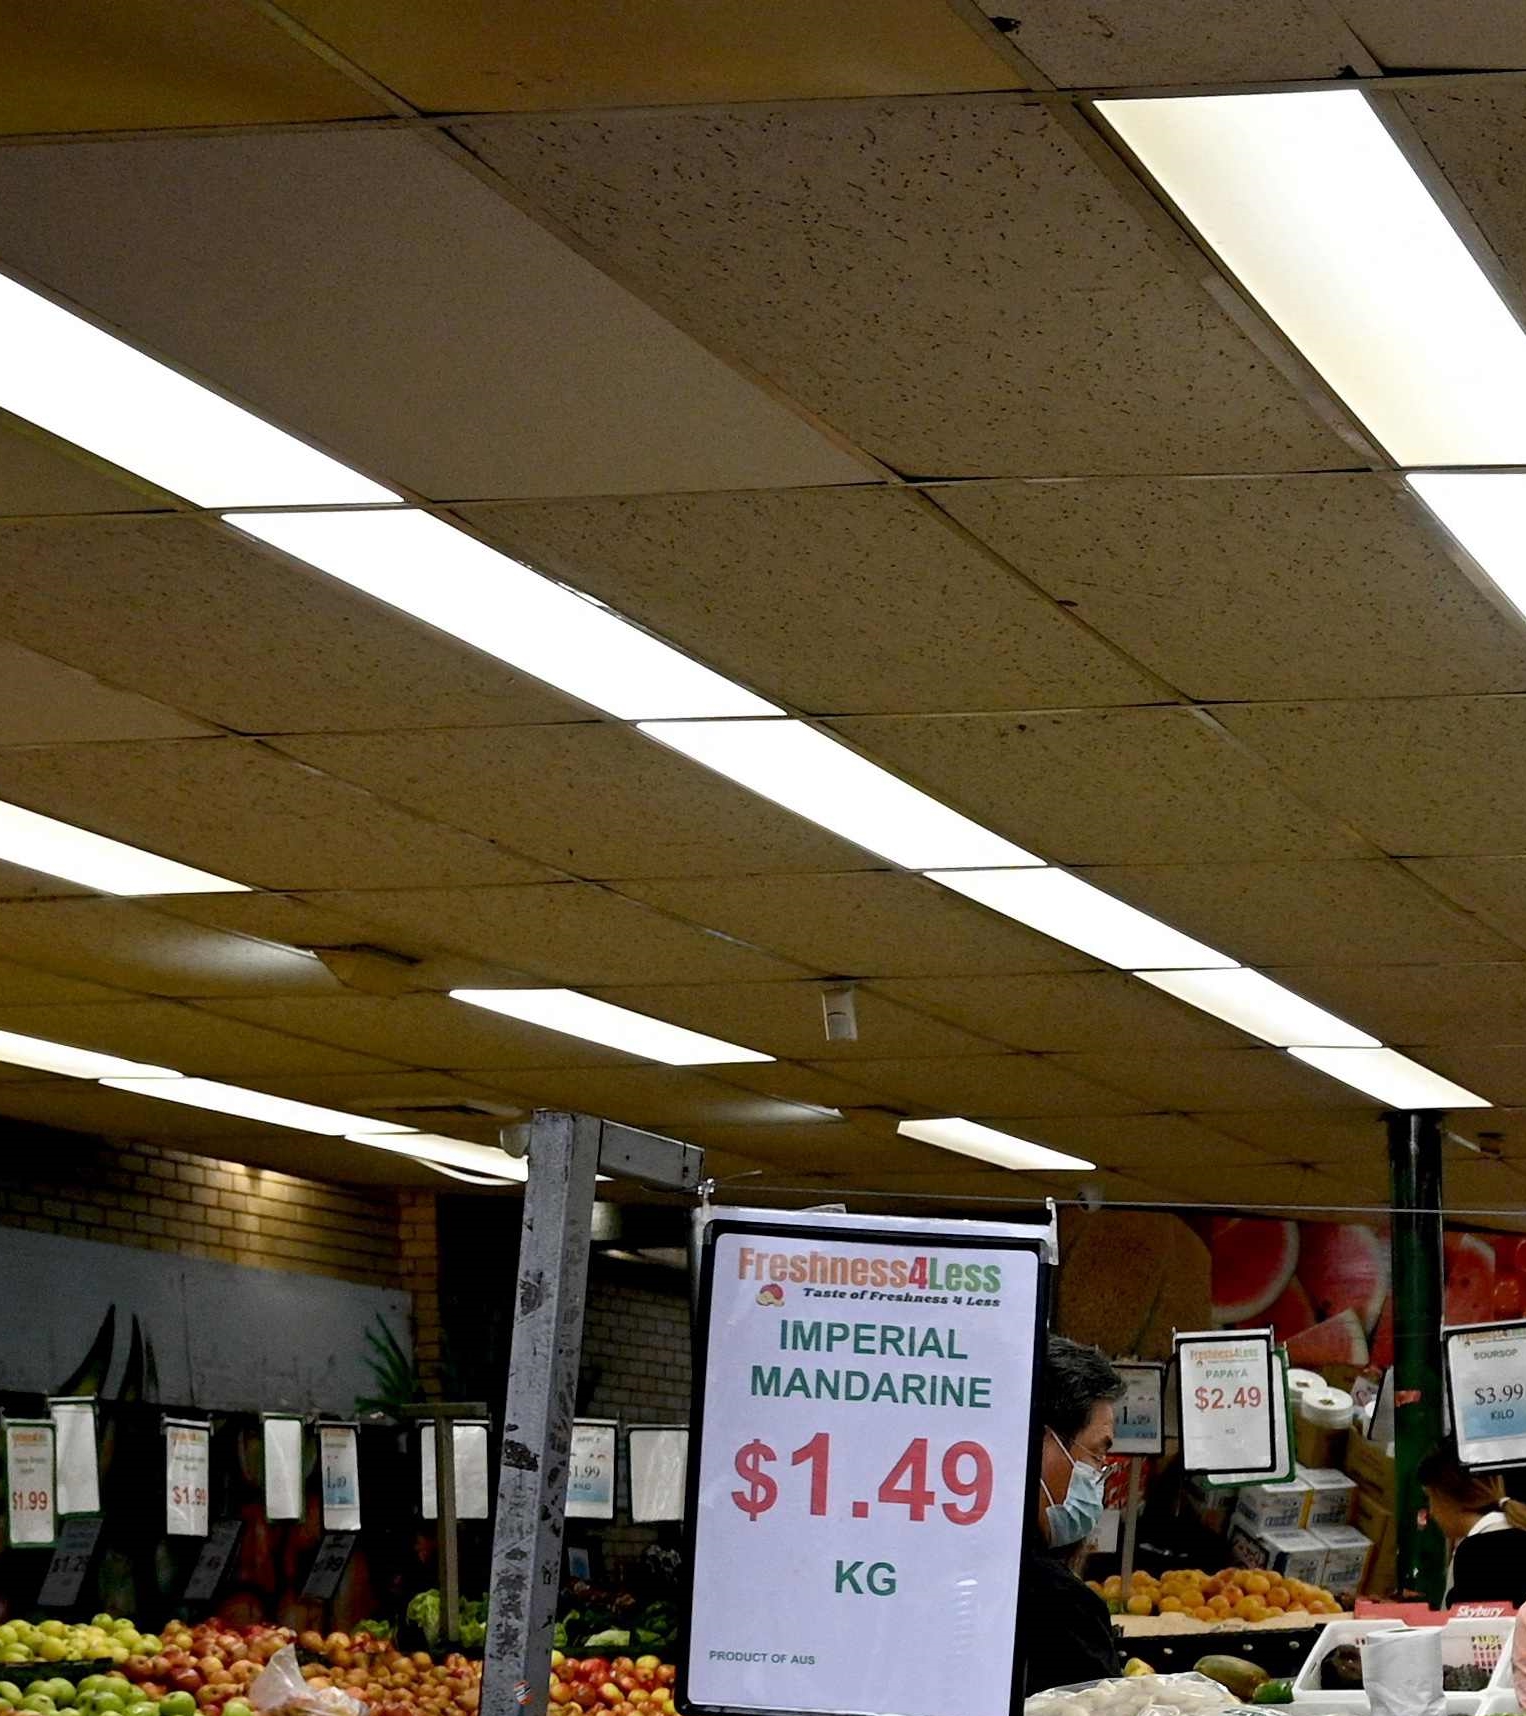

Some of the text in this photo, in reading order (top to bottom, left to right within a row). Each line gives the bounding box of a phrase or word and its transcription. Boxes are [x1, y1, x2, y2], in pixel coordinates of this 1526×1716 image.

[738, 1247, 1001, 1293] Freshness4Less
[802, 1288, 1001, 1307] Taste of Freshness 4 Less
[780, 1319, 968, 1360] IMPERIAL
[1206, 1368, 1248, 1379] PAPAYA
[751, 1366, 992, 1409] MANDARINE
[1194, 1386, 1262, 1412] $2.49
[1475, 1383, 1524, 1406] $3.99
[1490, 1409, 1515, 1420] KILO
[731, 1432, 994, 1526] $1.49
[835, 1560, 897, 1595] KG
[1456, 1604, 1506, 1619] Skybury
[709, 1650, 815, 1665] PRODUCT OF AUS
